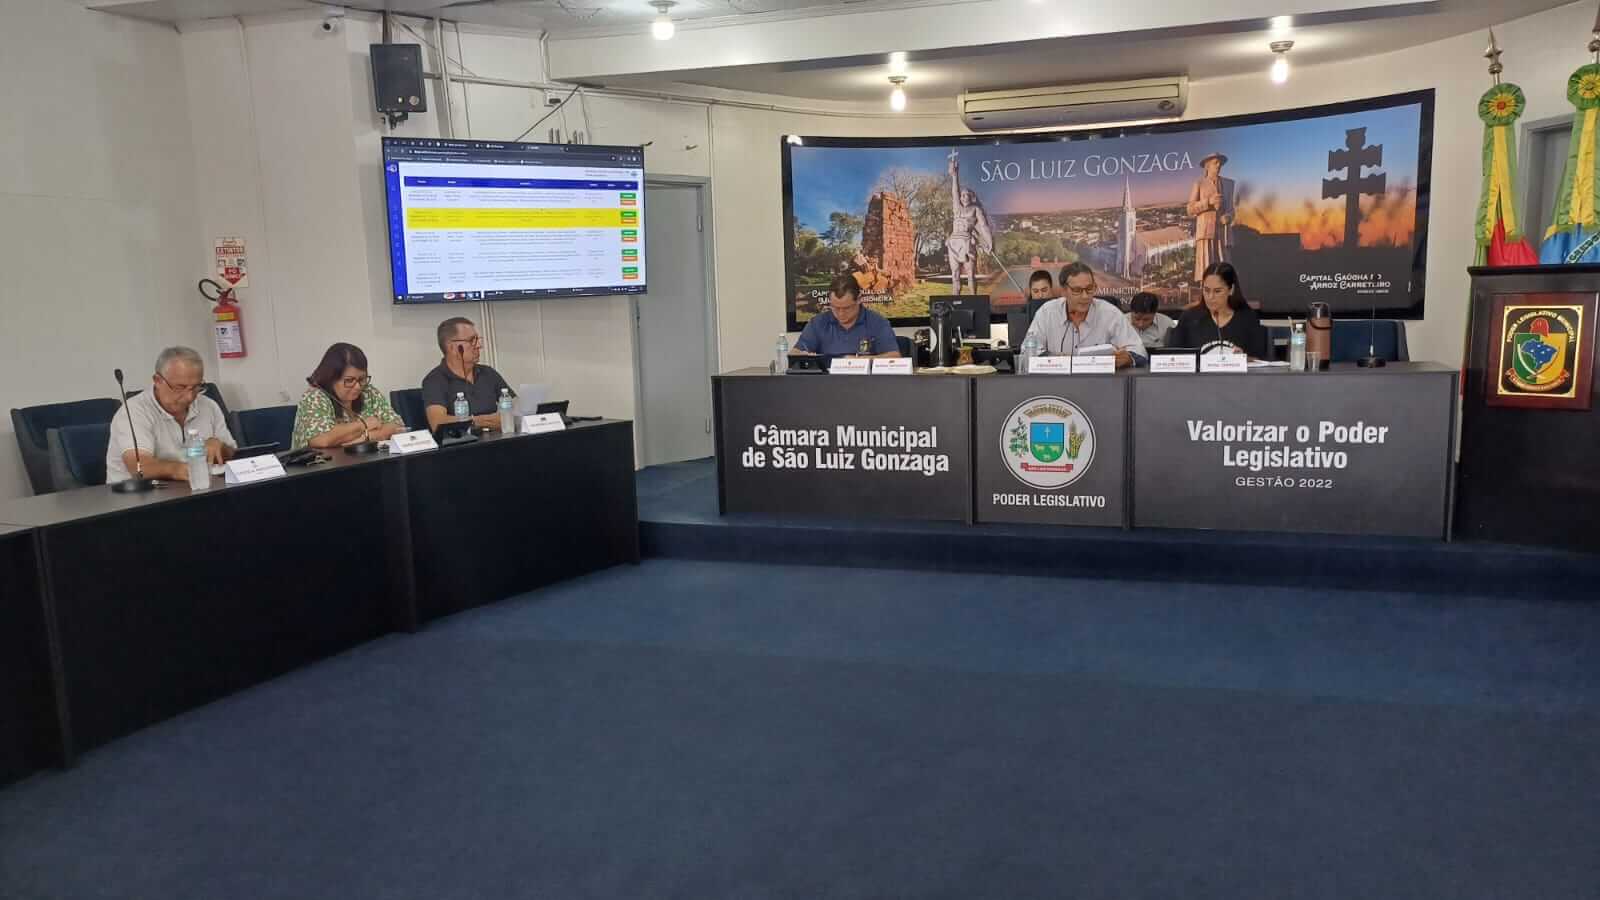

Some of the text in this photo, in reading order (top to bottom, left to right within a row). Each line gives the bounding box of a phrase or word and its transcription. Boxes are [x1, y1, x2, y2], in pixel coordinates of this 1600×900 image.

[980, 151, 1194, 182] SÃO LUIZ GONZAGA
[1299, 273, 1333, 282] CAPITAL
[1310, 281, 1338, 290] ARROZ
[753, 424, 937, 453] Câmara Municipal
[1187, 420, 1389, 444] Valorizar o Poder
[742, 446, 950, 476] de São Luiz Gonzaga
[1223, 445, 1348, 471] Legislativo
[1235, 475, 1334, 489] GESTÃO 2022
[992, 493, 1106, 508] PODER LEGISLATIVO
